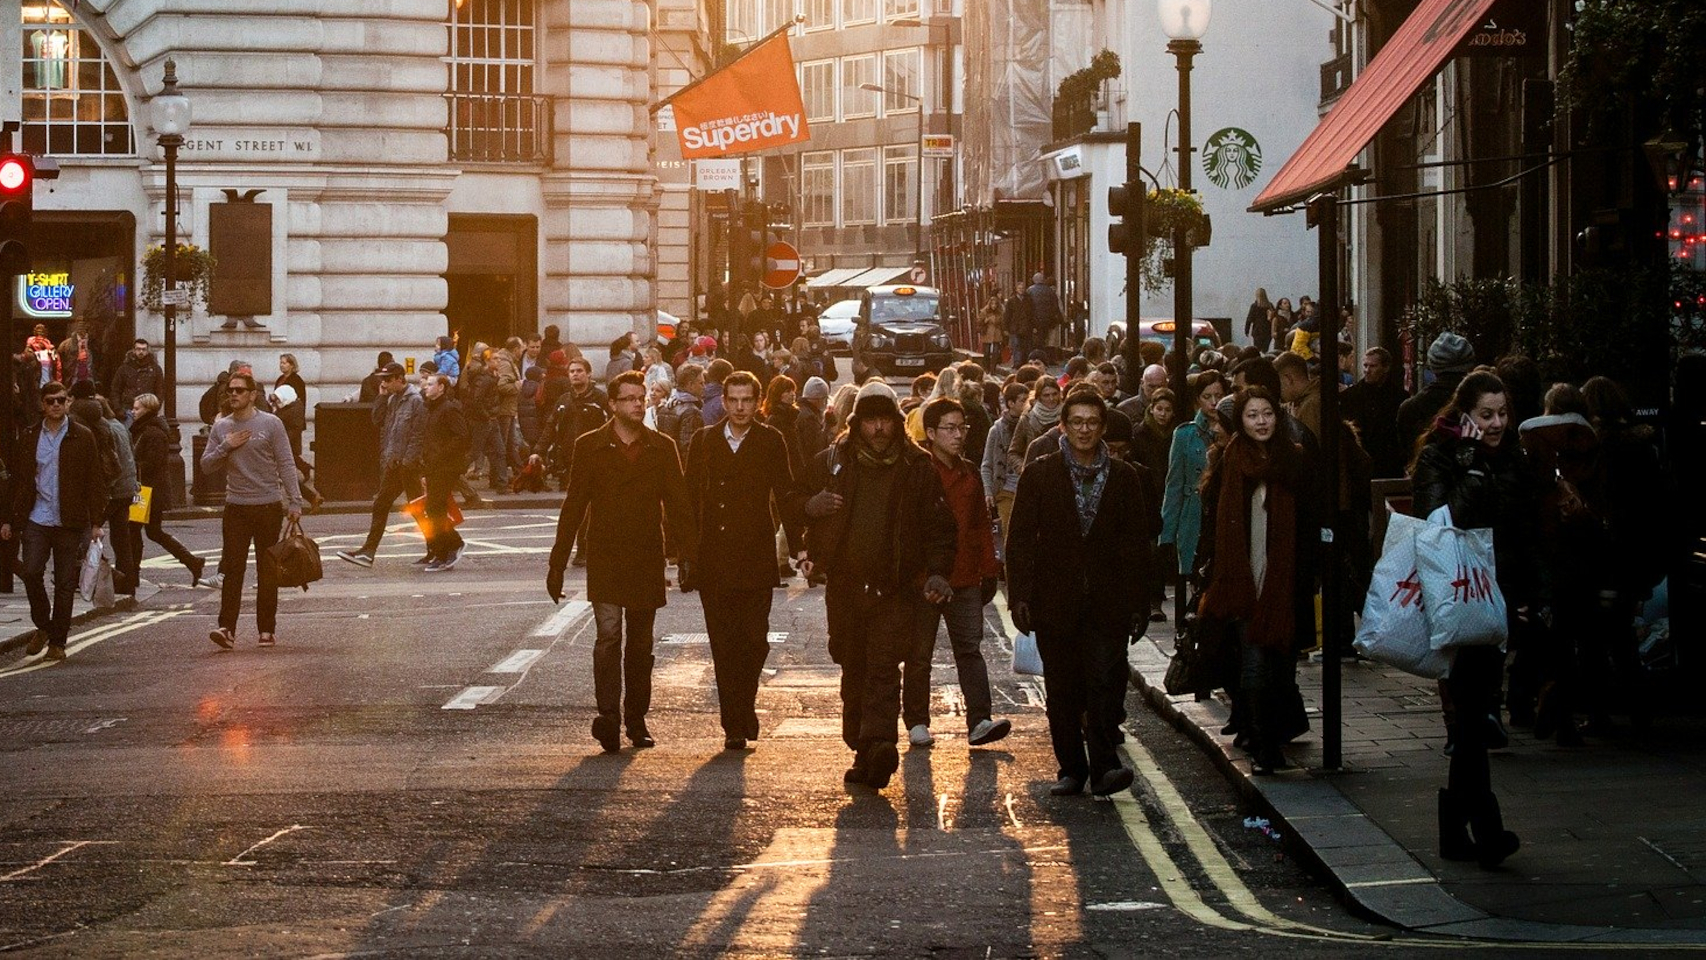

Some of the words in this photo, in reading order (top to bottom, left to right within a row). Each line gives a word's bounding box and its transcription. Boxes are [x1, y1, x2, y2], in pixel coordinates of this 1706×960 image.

[235, 140, 285, 151] STREET
[682, 112, 800, 150] Superdry
[1450, 564, 1495, 606] H&M
